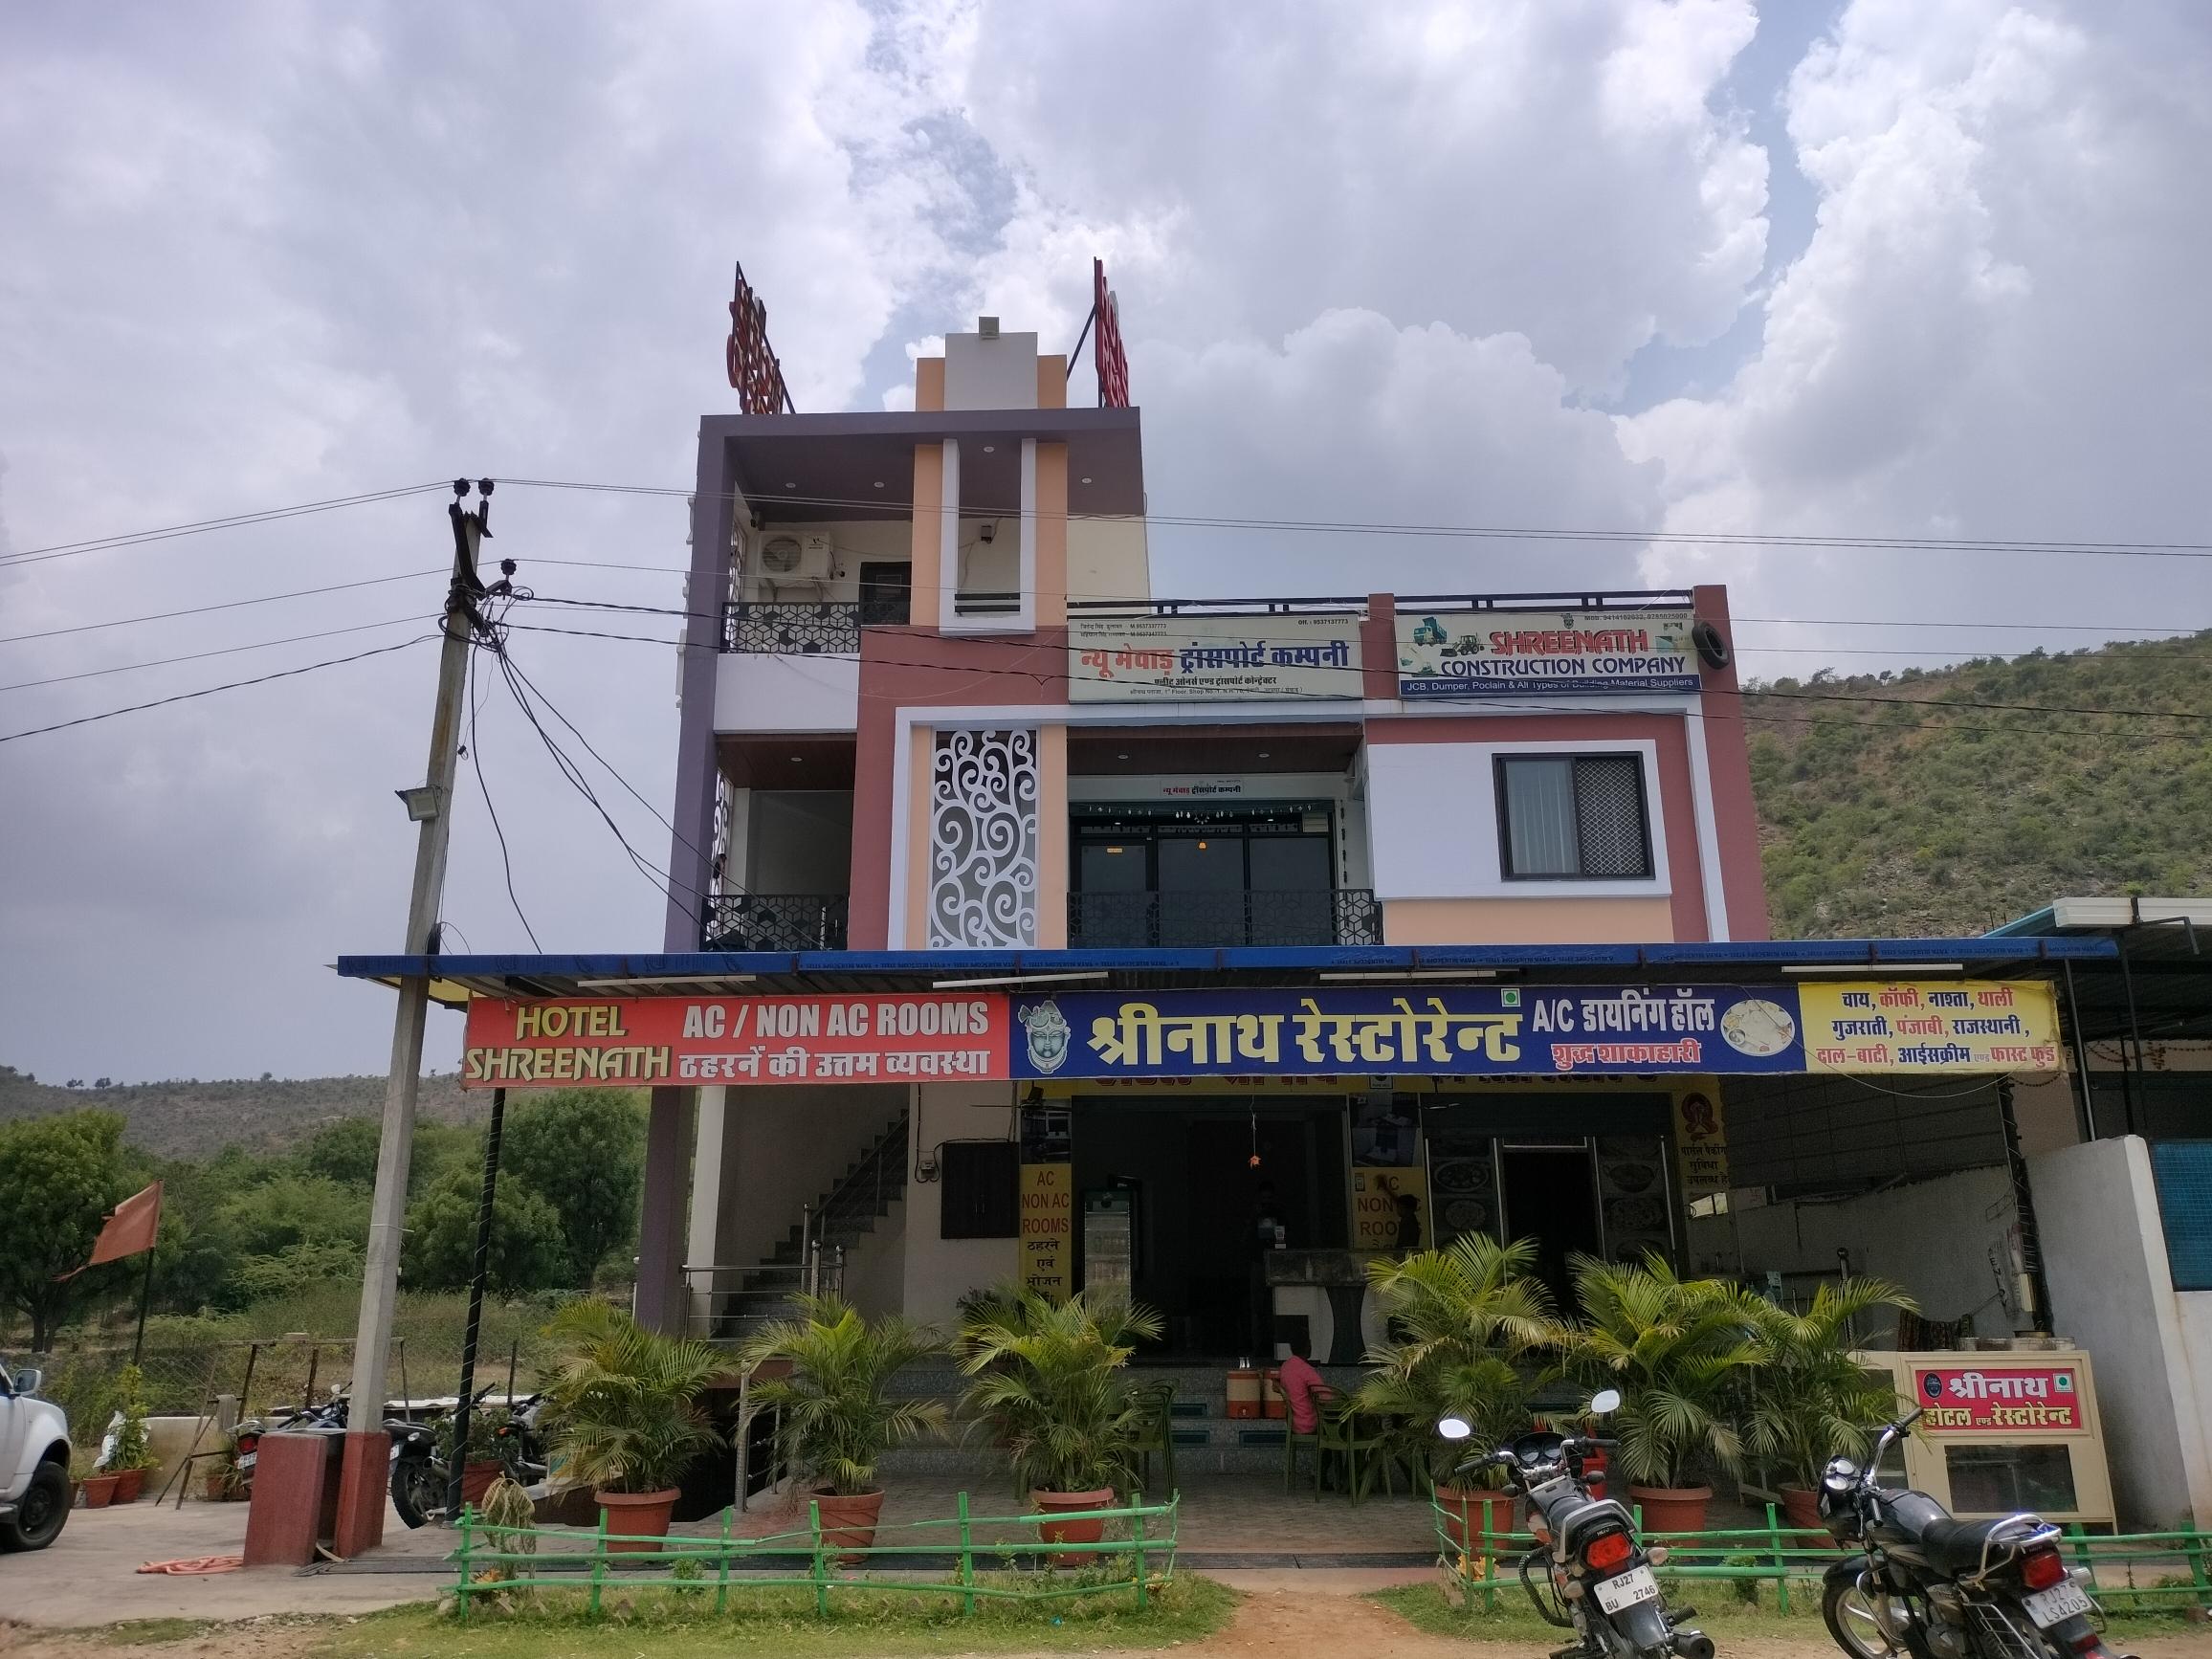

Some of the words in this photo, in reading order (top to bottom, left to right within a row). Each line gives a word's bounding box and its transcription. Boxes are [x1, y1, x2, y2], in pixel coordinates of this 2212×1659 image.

[1489, 630, 1648, 655] SHREENATH
[1080, 649, 1115, 677] न्यू
[1179, 641, 1266, 674] ट्रांसपोर्ट
[1270, 640, 1350, 668] कम्पनी
[1440, 657, 1585, 676] CONSTRUCTION
[1592, 656, 1686, 675] COMPANY
[1472, 681, 1506, 690] Poclain
[1650, 677, 1693, 689] Suppliers
[1532, 999, 1575, 1032] A/C
[1581, 987, 1667, 1031] डायनिंग
[1669, 987, 1715, 1031] हॉल
[1841, 992, 1876, 1010] चाय,
[1878, 987, 1925, 1010] कॉफी,
[1927, 991, 1974, 1010] नाश्ता,
[1977, 986, 2013, 1006] थाली
[516, 1006, 630, 1040] HOTEL
[682, 1005, 726, 1039] AC
[732, 1004, 749, 1038] /
[756, 1004, 820, 1038] NON
[826, 1003, 869, 1037] AC
[876, 1001, 989, 1036] ROOMS
[1086, 1003, 1285, 1065] श्रीनाथ
[1292, 997, 1524, 1063] रेस्टोरेन्ट
[1831, 1015, 1893, 1041] गुजराती,
[1895, 1014, 1949, 1038] पंजाबी,
[465, 1046, 671, 1082] SHREENATH
[767, 1046, 810, 1077] की
[813, 1052, 881, 1076] उत्तम
[884, 1050, 991, 1075] व्यवस्था
[1551, 1043, 1595, 1072] शुद्ध
[1596, 1037, 1702, 1064] शाकाहारी
[1897, 1042, 1970, 1065] आईसक्रीम
[1990, 1046, 2027, 1063] फास्ट
[1036, 1170, 1055, 1186] AC
[1022, 1193, 1049, 1209] NON
[1052, 1192, 1070, 1208] AC
[1358, 1197, 1394, 1212] NON
[1022, 1218, 1070, 1234] ROOMS
[1948, 1372, 2048, 1399] श्रीनाथ
[1991, 1401, 2071, 1426] रेस्टोरेन्ट
[1612, 1574, 1634, 1590] RJ27
[1605, 1599, 1619, 1612] BU
[1633, 1584, 1656, 1601] 2746
